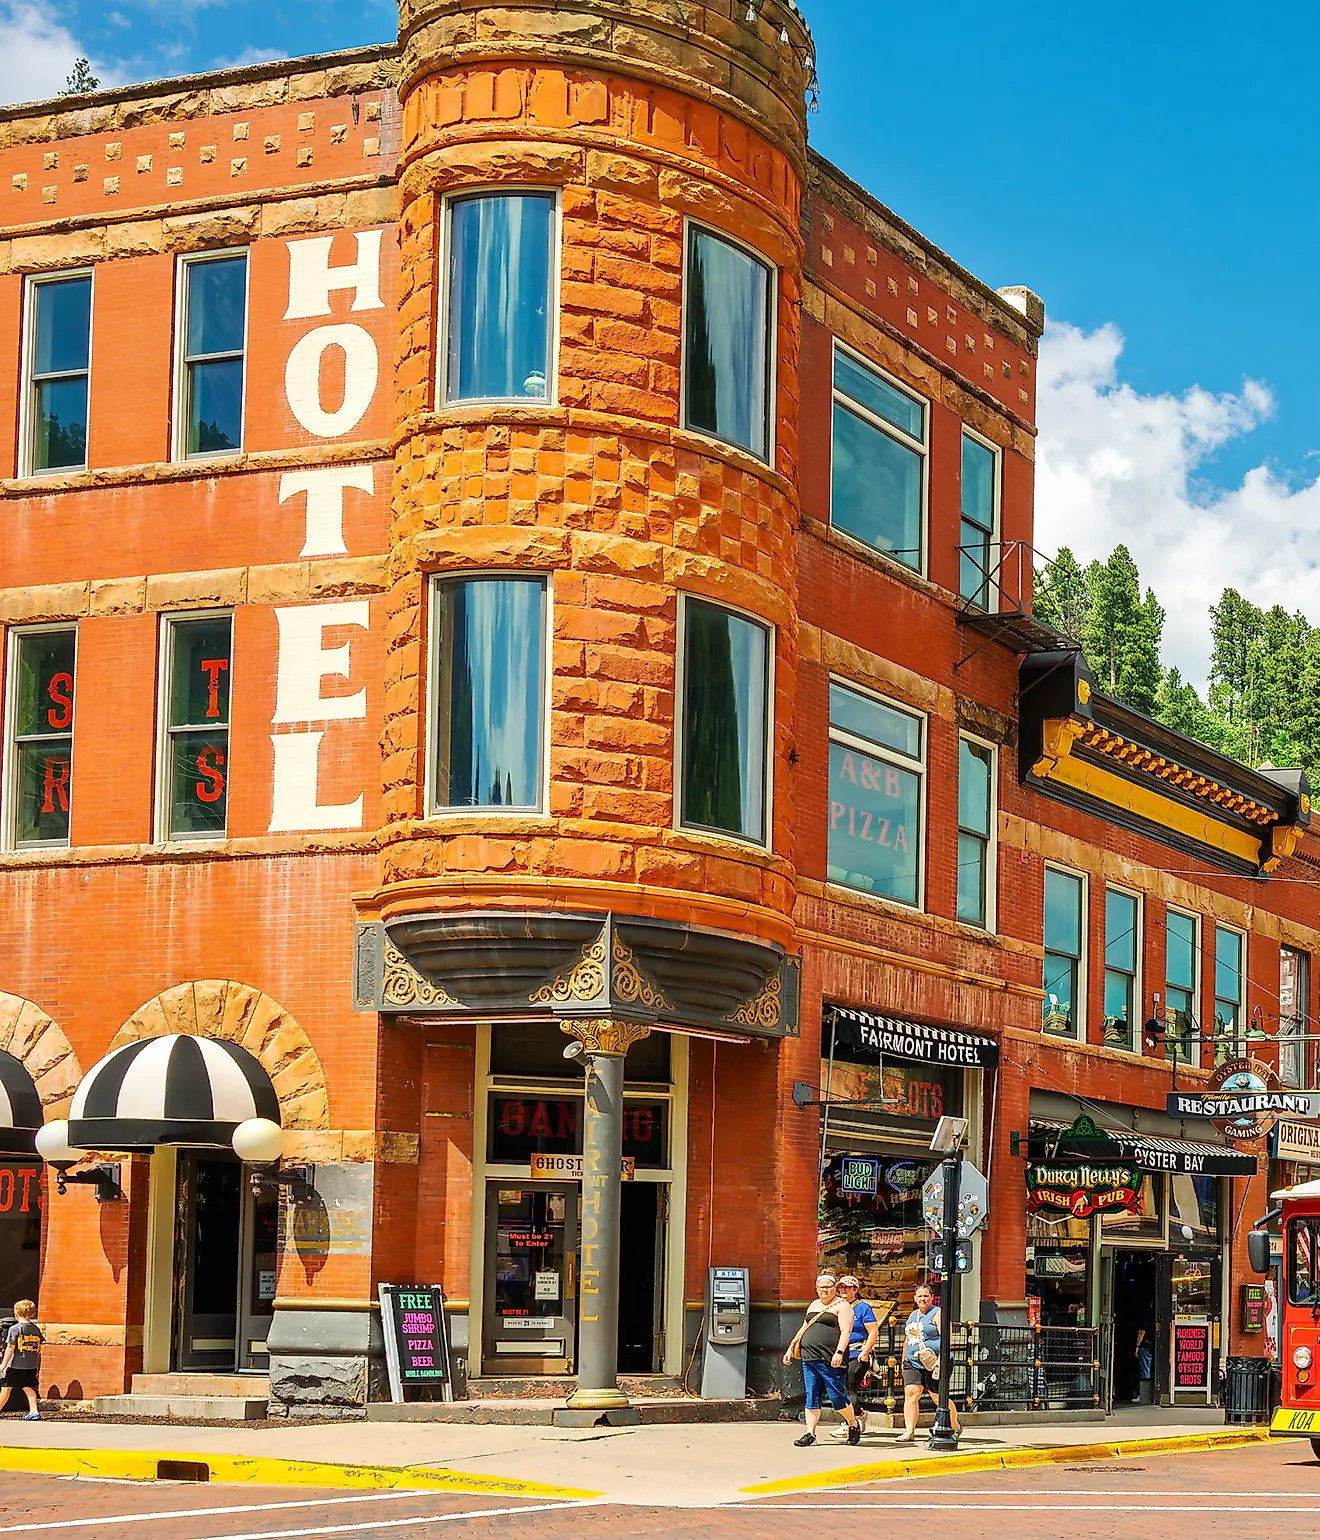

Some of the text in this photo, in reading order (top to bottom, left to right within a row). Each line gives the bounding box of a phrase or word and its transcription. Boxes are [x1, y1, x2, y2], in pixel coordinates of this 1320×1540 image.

[267, 229, 386, 832] HOTEL
[202, 659, 228, 718] T
[47, 672, 73, 729] S
[196, 746, 225, 802] S
[840, 753, 901, 798] A&B
[830, 801, 909, 855] PIZZA
[860, 1025, 981, 1064] FAIRMONT HOTEL
[1216, 1061, 1274, 1083] OYSTER BAY
[883, 1075, 944, 1118] SLOTS
[1177, 1094, 1310, 1116] RESTAURANT
[503, 1100, 654, 1142] GAMG
[1224, 1124, 1263, 1138] GAMING
[848, 1161, 873, 1176] BUD
[1134, 1148, 1205, 1172] OYSTER BAY
[843, 1174, 876, 1191] LIGHT
[1037, 1189, 1125, 1207] IRISH PUB
[399, 1294, 433, 1309] FREE
[403, 1313, 432, 1324] JUMBO
[402, 1323, 435, 1334] SHRIMP
[408, 1340, 434, 1350] PIZZA
[1179, 1339, 1204, 1350] WORLD
[411, 1356, 434, 1367] BEER
[1177, 1351, 1205, 1362] FAMOUS
[1177, 1362, 1204, 1373] OYSTER
[1179, 1374, 1202, 1385] SHOTS
[1288, 1411, 1316, 1430] KOA
